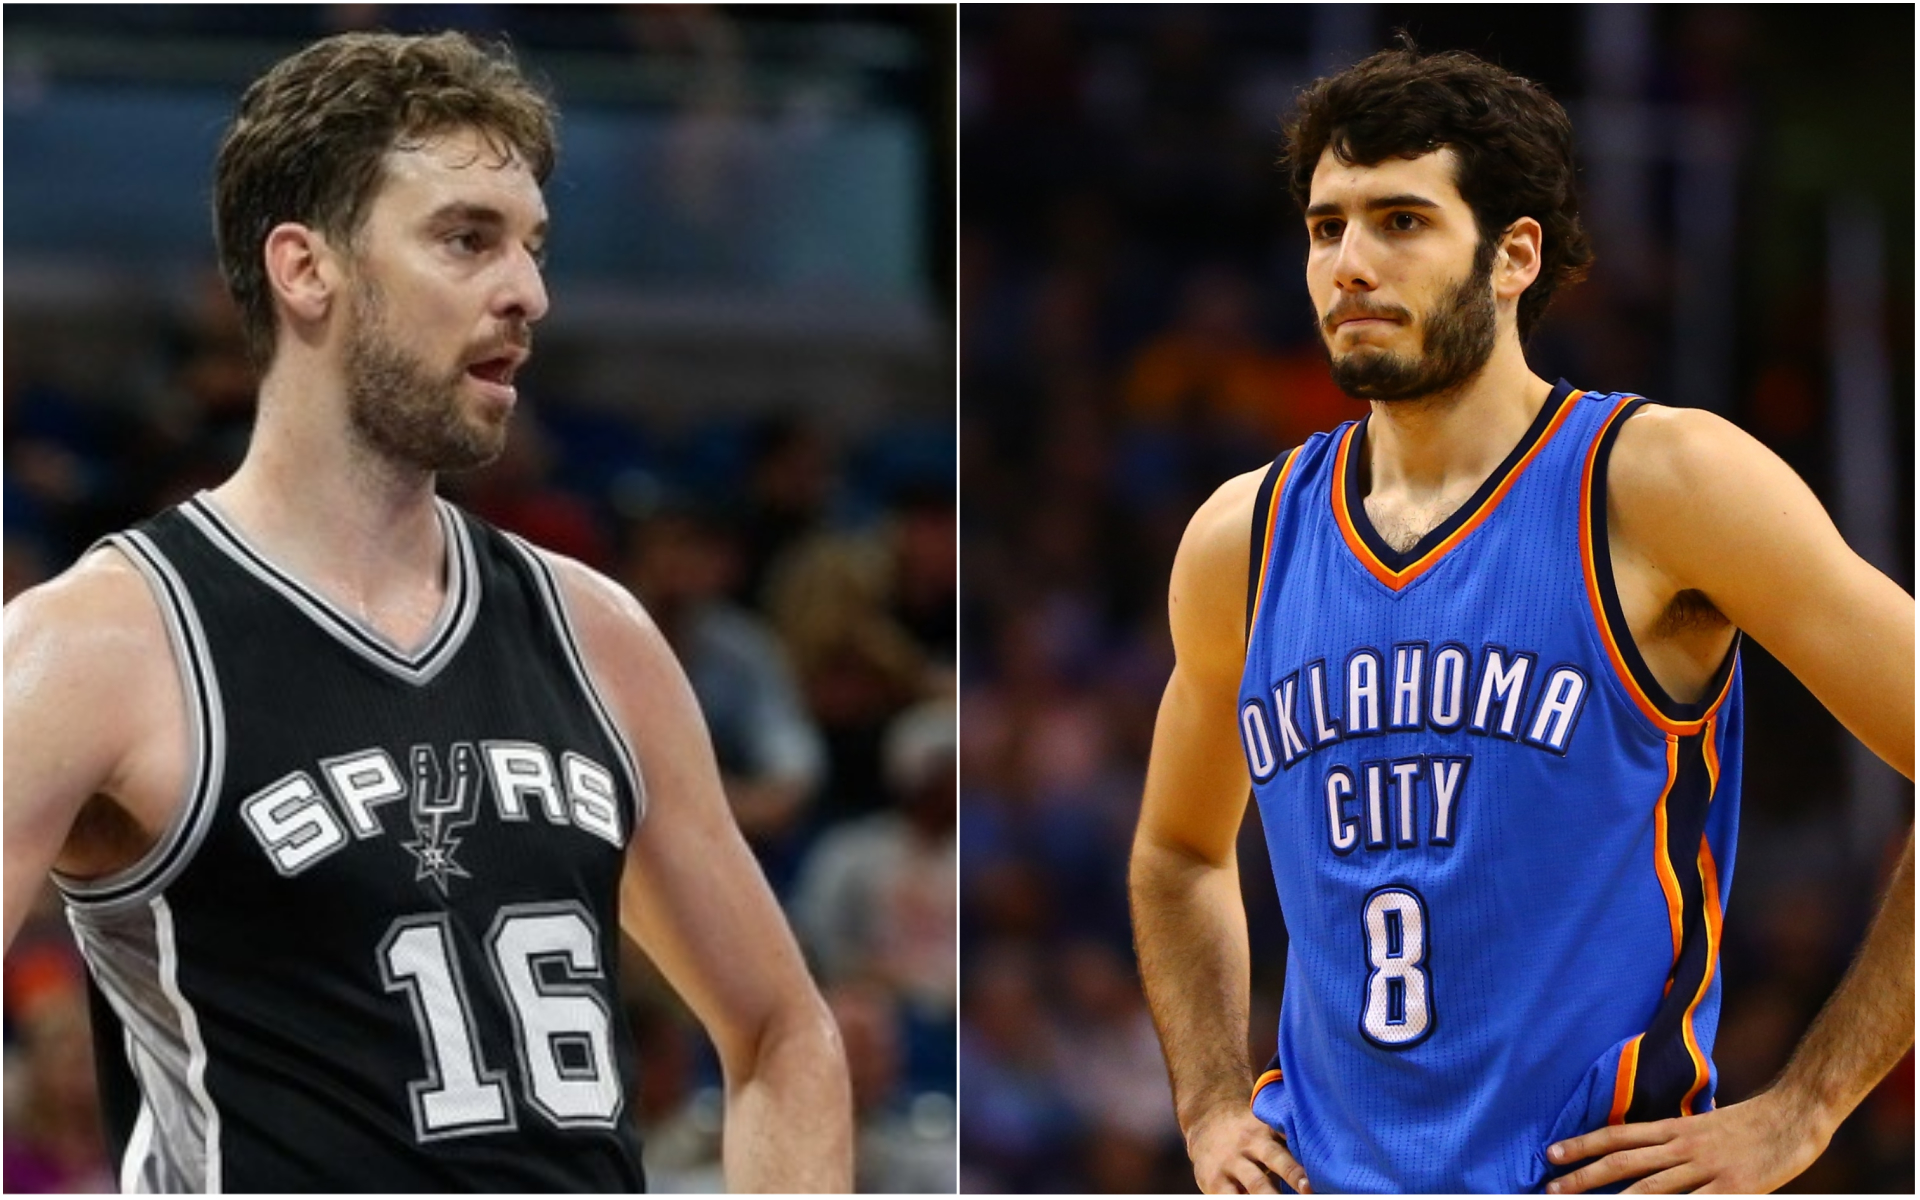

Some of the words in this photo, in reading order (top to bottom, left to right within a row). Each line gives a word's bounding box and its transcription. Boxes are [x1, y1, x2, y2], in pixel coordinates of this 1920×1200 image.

[1240, 640, 1591, 785] OKLAHOMA
[240, 740, 625, 880] SPURS
[1324, 753, 1472, 856] CITY
[376, 900, 625, 1143] 16
[1359, 883, 1436, 1051] 8
